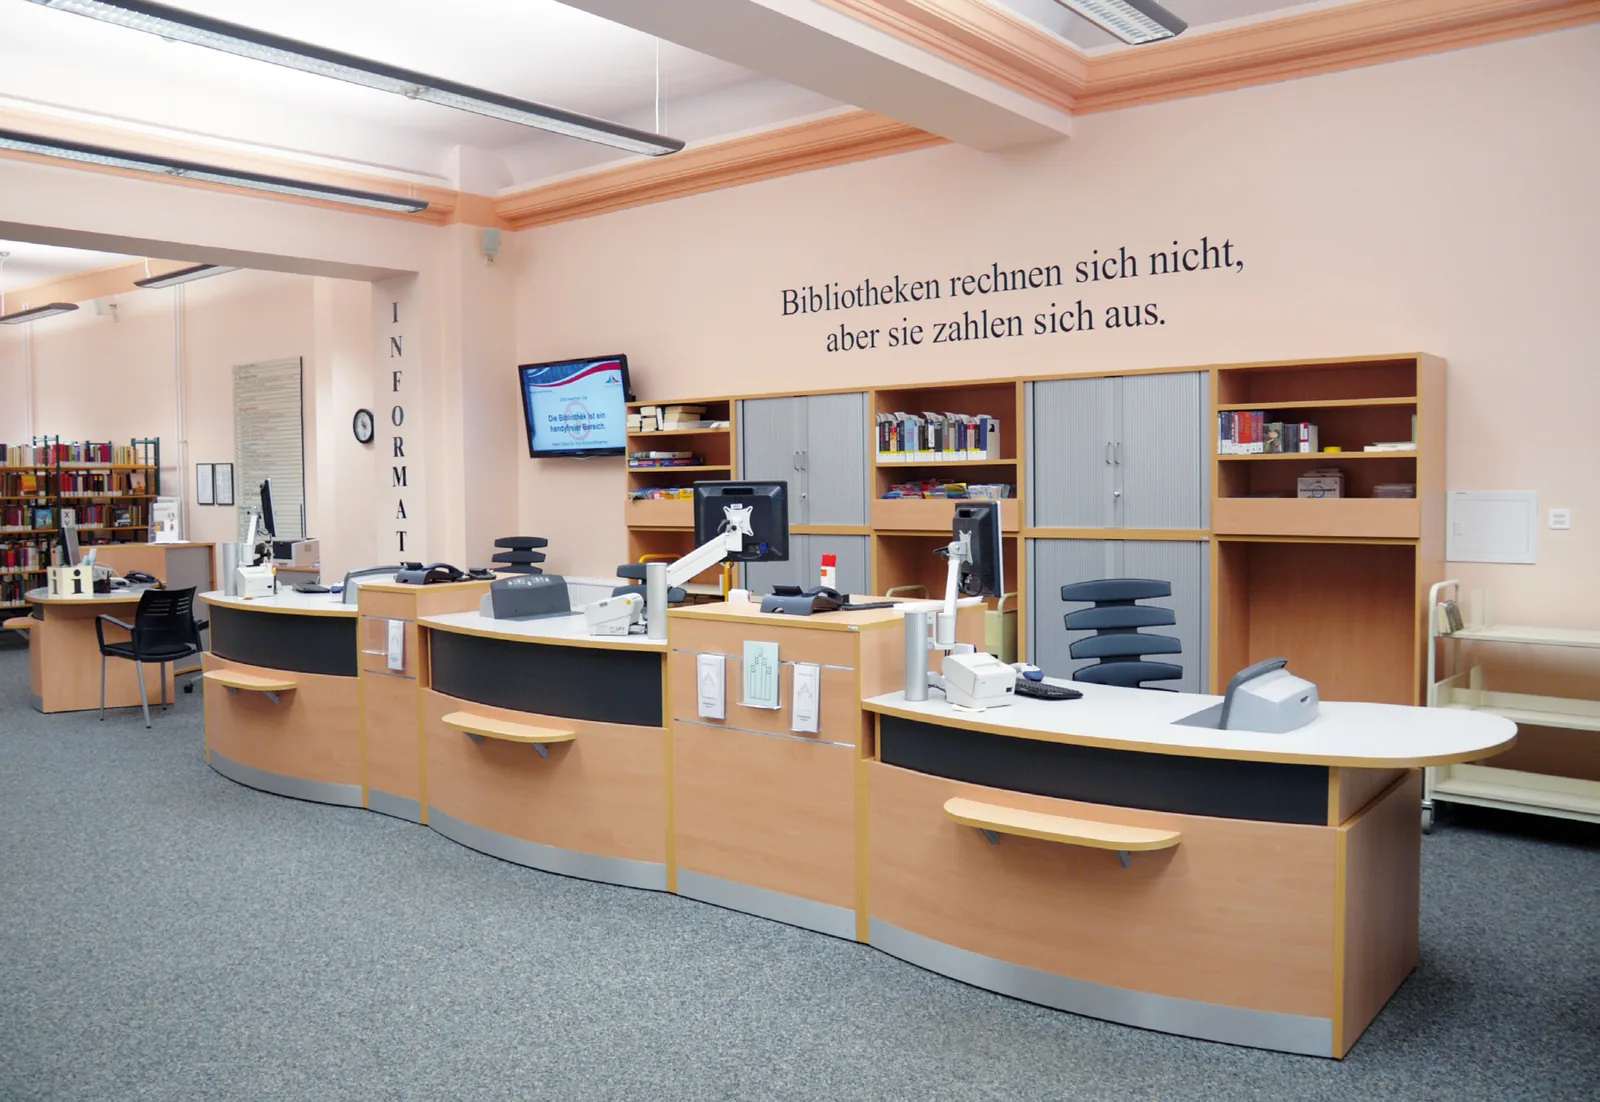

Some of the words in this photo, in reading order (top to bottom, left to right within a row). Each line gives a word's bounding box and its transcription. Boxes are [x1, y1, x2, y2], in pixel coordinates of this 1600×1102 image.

[781, 274, 941, 316] Bibliotheken
[949, 262, 1063, 298] rechnen
[1075, 246, 1139, 283] sich
[1149, 236, 1244, 276] nicht,
[826, 323, 881, 353] aber
[888, 317, 924, 347] sie
[932, 309, 1023, 344] zahlen
[1034, 299, 1095, 335] sich
[1105, 303, 1166, 329] aus.
[390, 301, 407, 566] INFORMAT
[548, 414, 557, 422] Die
[558, 413, 586, 422] Bibliothek
[596, 411, 606, 419] ein
